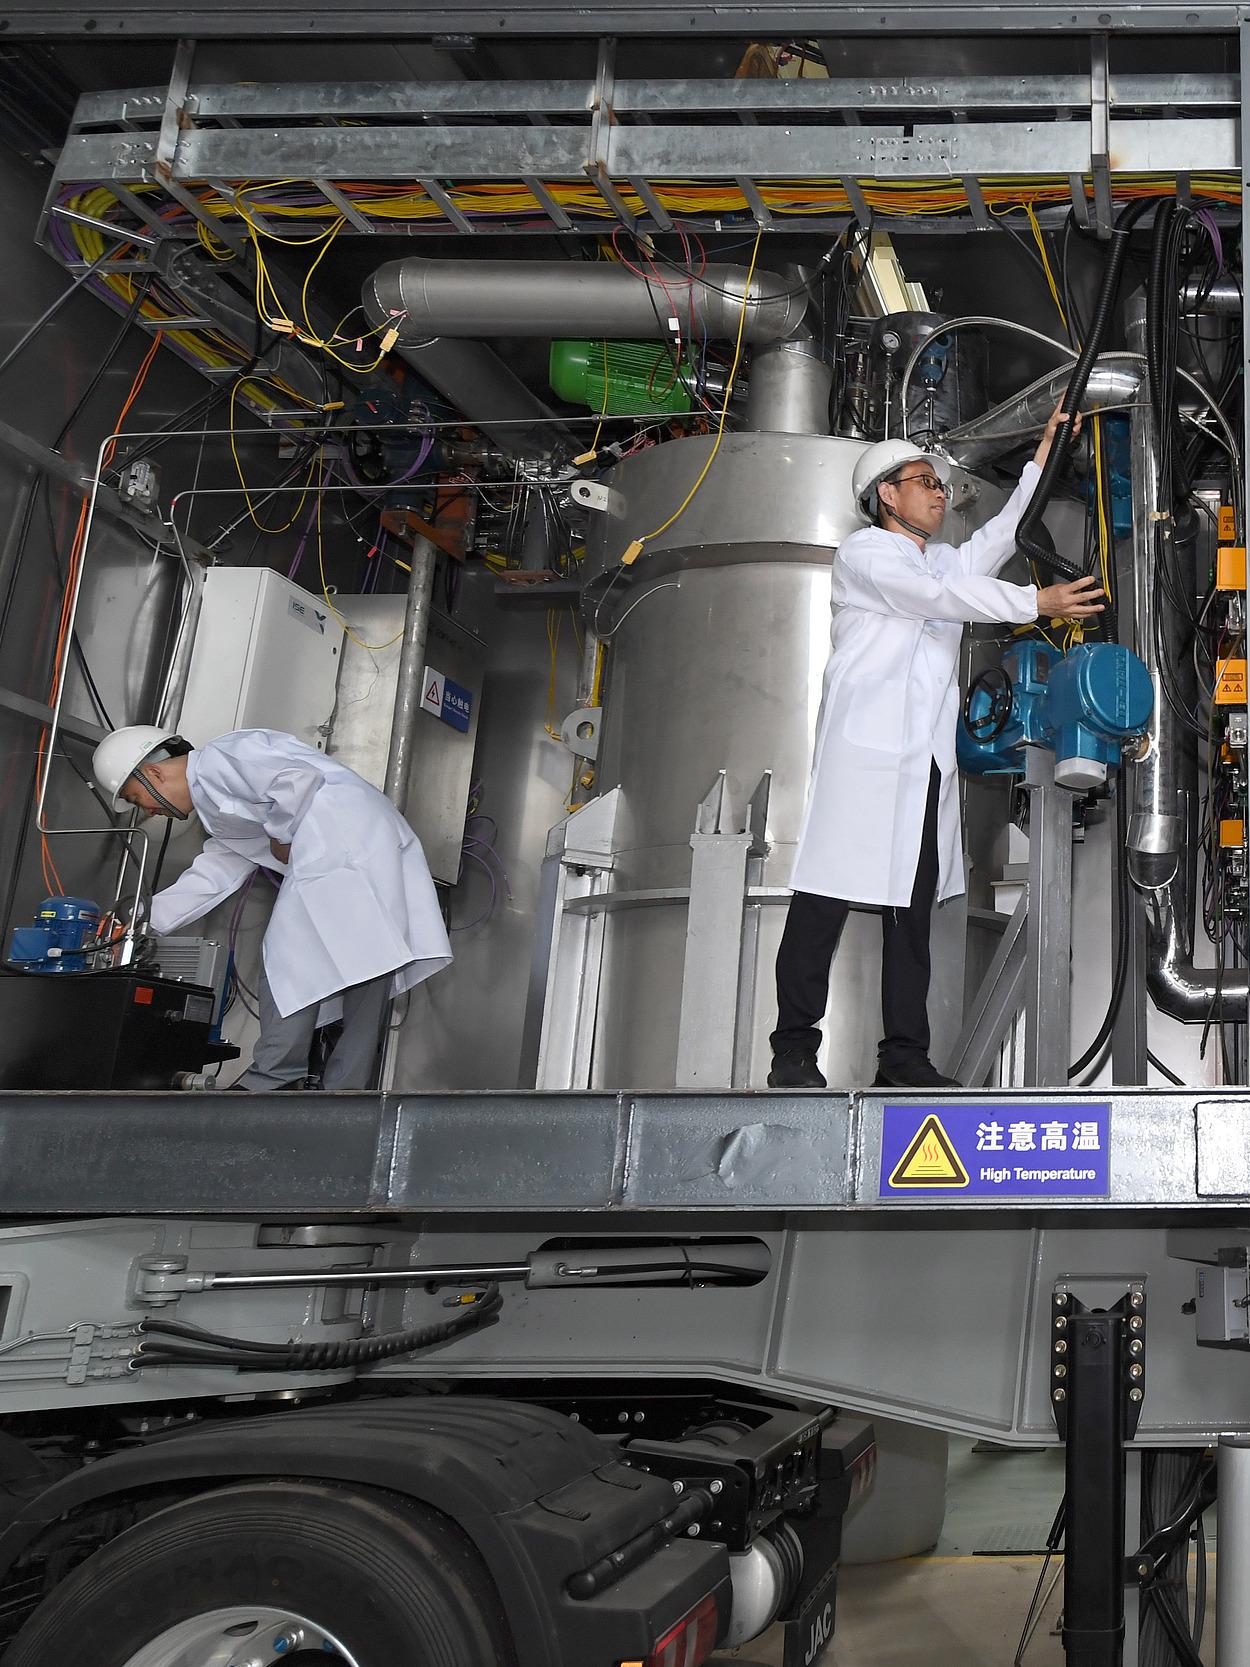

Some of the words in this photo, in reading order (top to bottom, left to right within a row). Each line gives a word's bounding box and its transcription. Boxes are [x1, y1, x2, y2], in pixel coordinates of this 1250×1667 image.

[976, 1121, 1101, 1151] 注意高温
[980, 1167, 1011, 1183] High
[1013, 1167, 1096, 1182] Temperature
[805, 1602, 831, 1666] JAC
